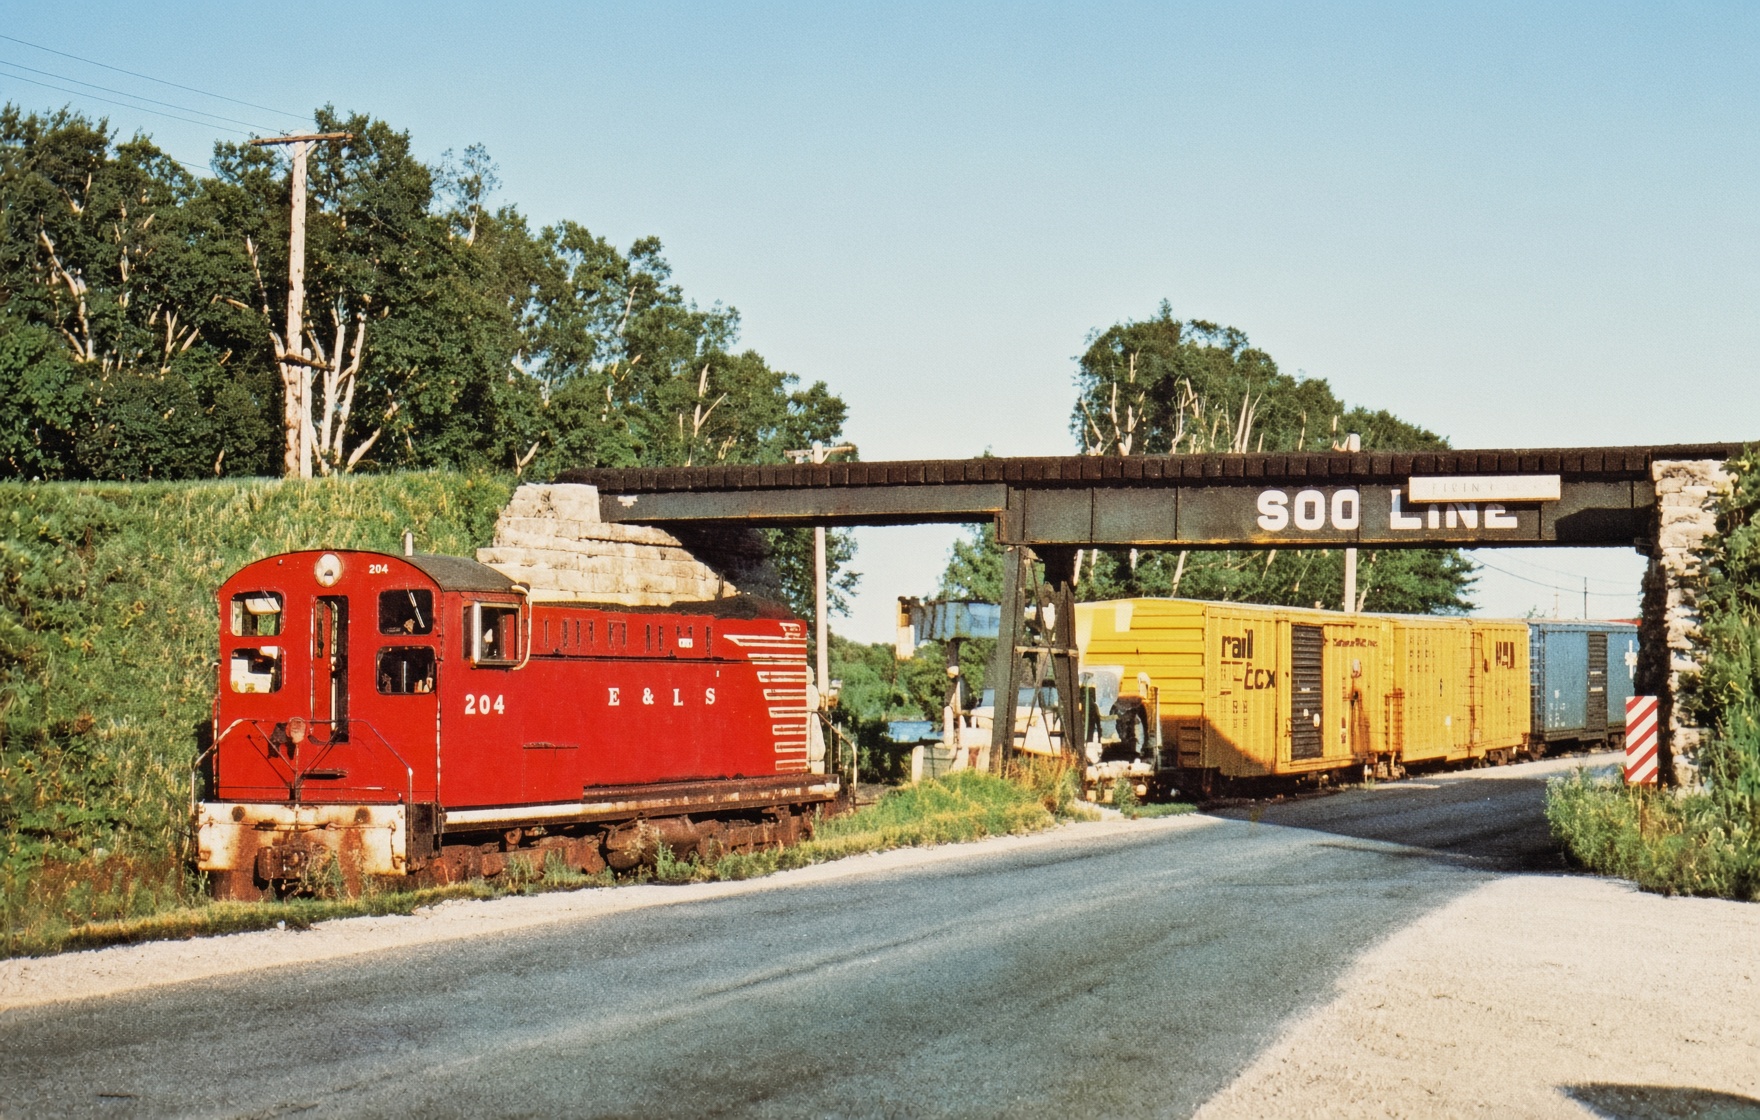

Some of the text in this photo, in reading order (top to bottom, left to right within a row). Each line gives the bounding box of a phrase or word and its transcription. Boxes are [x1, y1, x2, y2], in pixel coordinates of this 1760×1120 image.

[1257, 489, 1518, 531] SOO LINE
[368, 563, 389, 575] 204
[1221, 628, 1253, 659] rail
[464, 693, 505, 715] 204
[607, 687, 716, 706] E & L S
